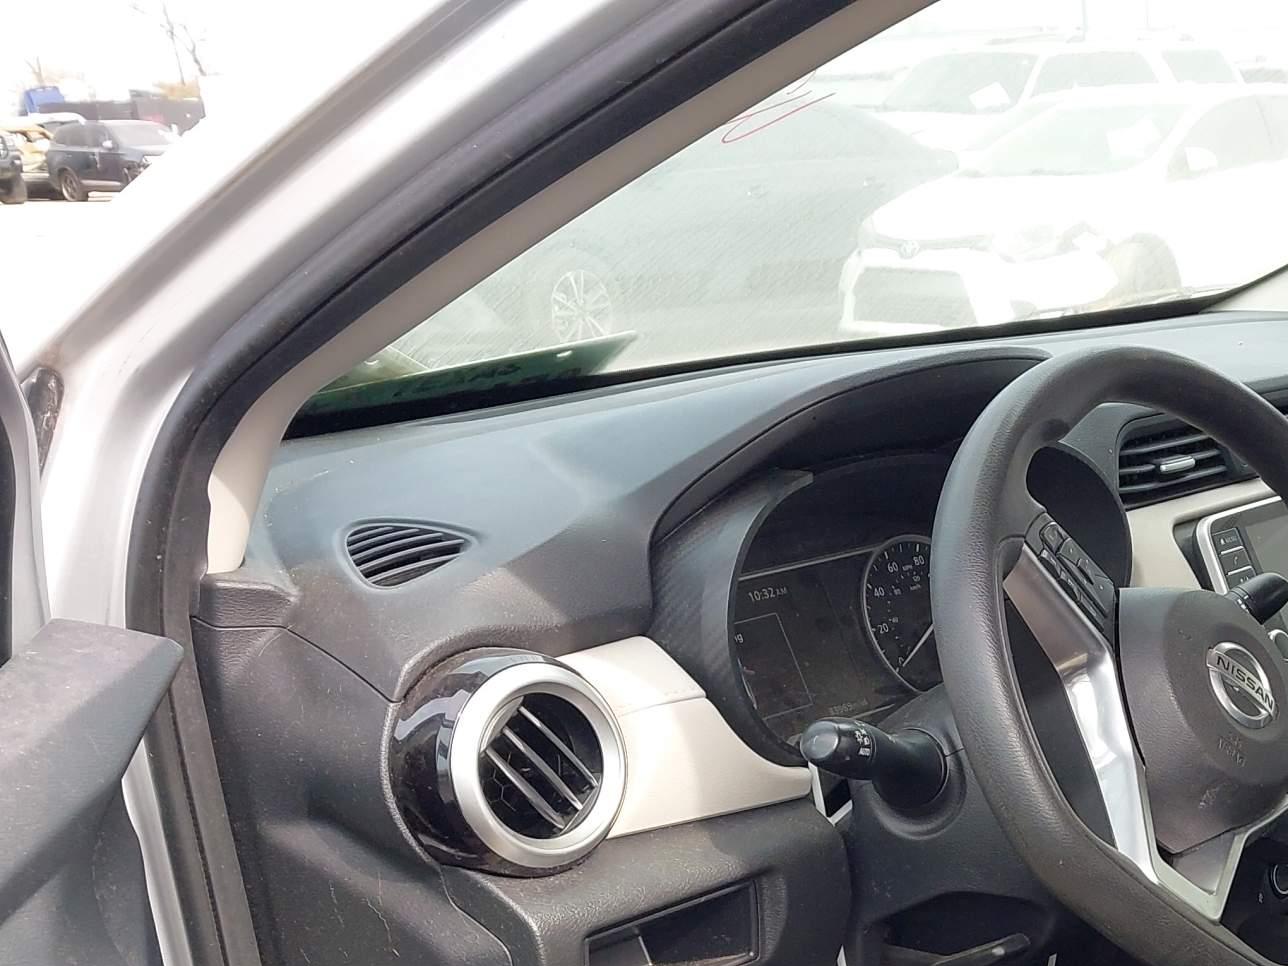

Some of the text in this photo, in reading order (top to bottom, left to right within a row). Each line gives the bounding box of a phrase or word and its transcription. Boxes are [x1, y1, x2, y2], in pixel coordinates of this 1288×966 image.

[887, 562, 899, 573] 60
[874, 586, 885, 598] 40
[878, 623, 889, 634] 20
[1216, 655, 1274, 710] NISSAN
